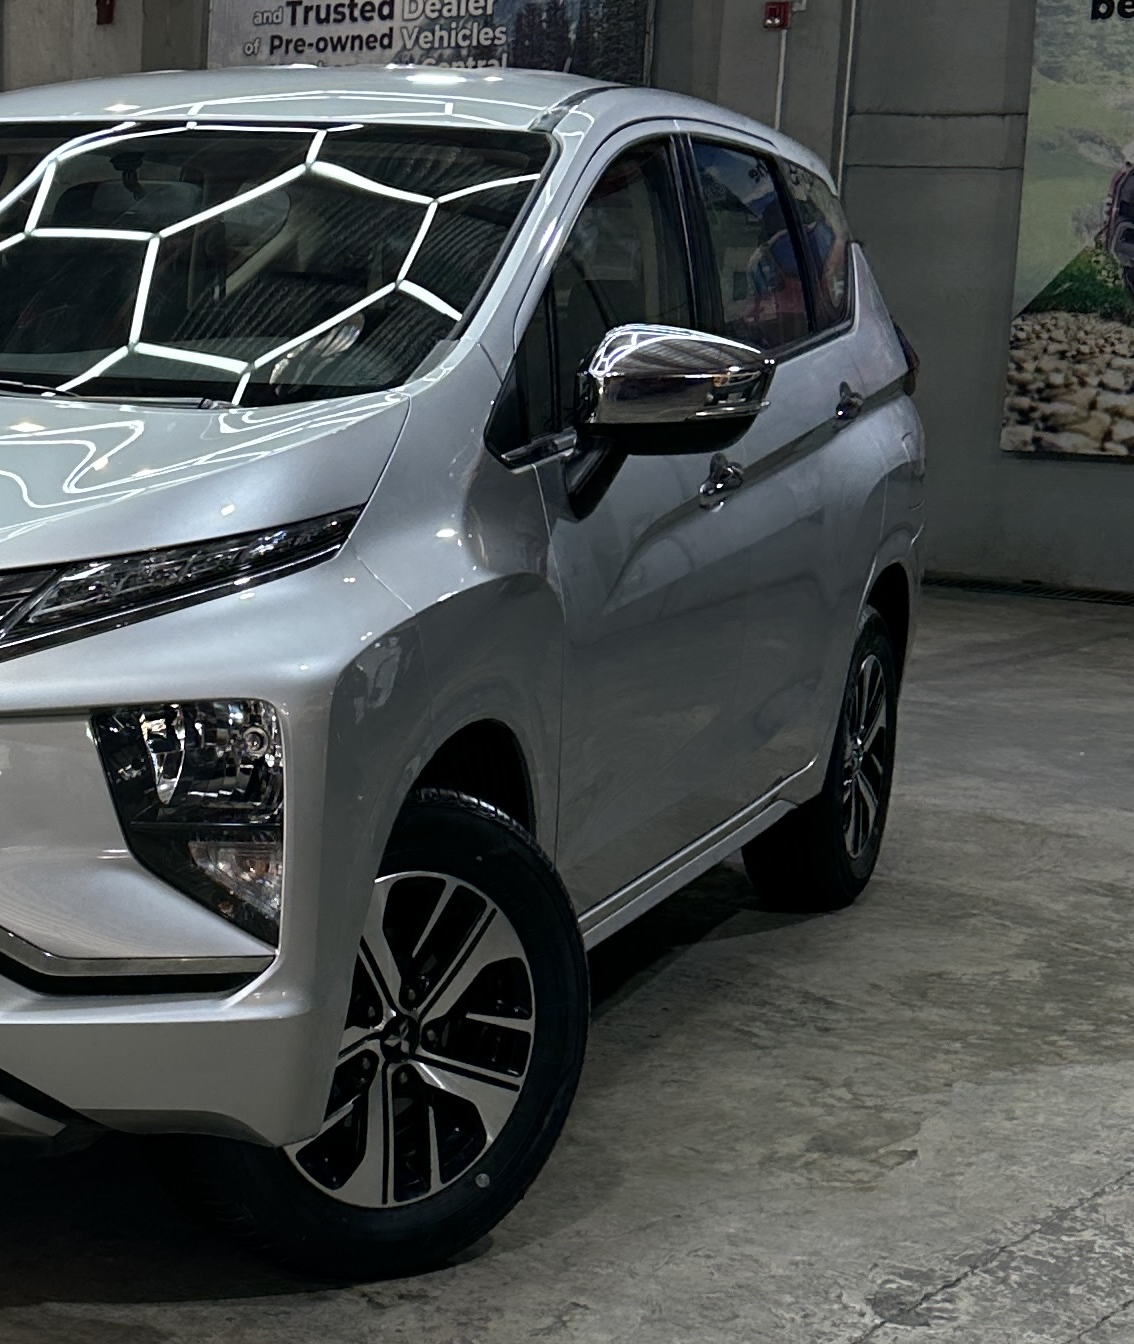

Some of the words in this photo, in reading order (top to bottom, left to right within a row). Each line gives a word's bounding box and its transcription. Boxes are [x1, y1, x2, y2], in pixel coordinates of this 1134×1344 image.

[252, 6, 283, 26] and
[243, 38, 261, 56] of
[269, 27, 393, 55] Pre-owned
[400, 22, 507, 50] Vehicles
